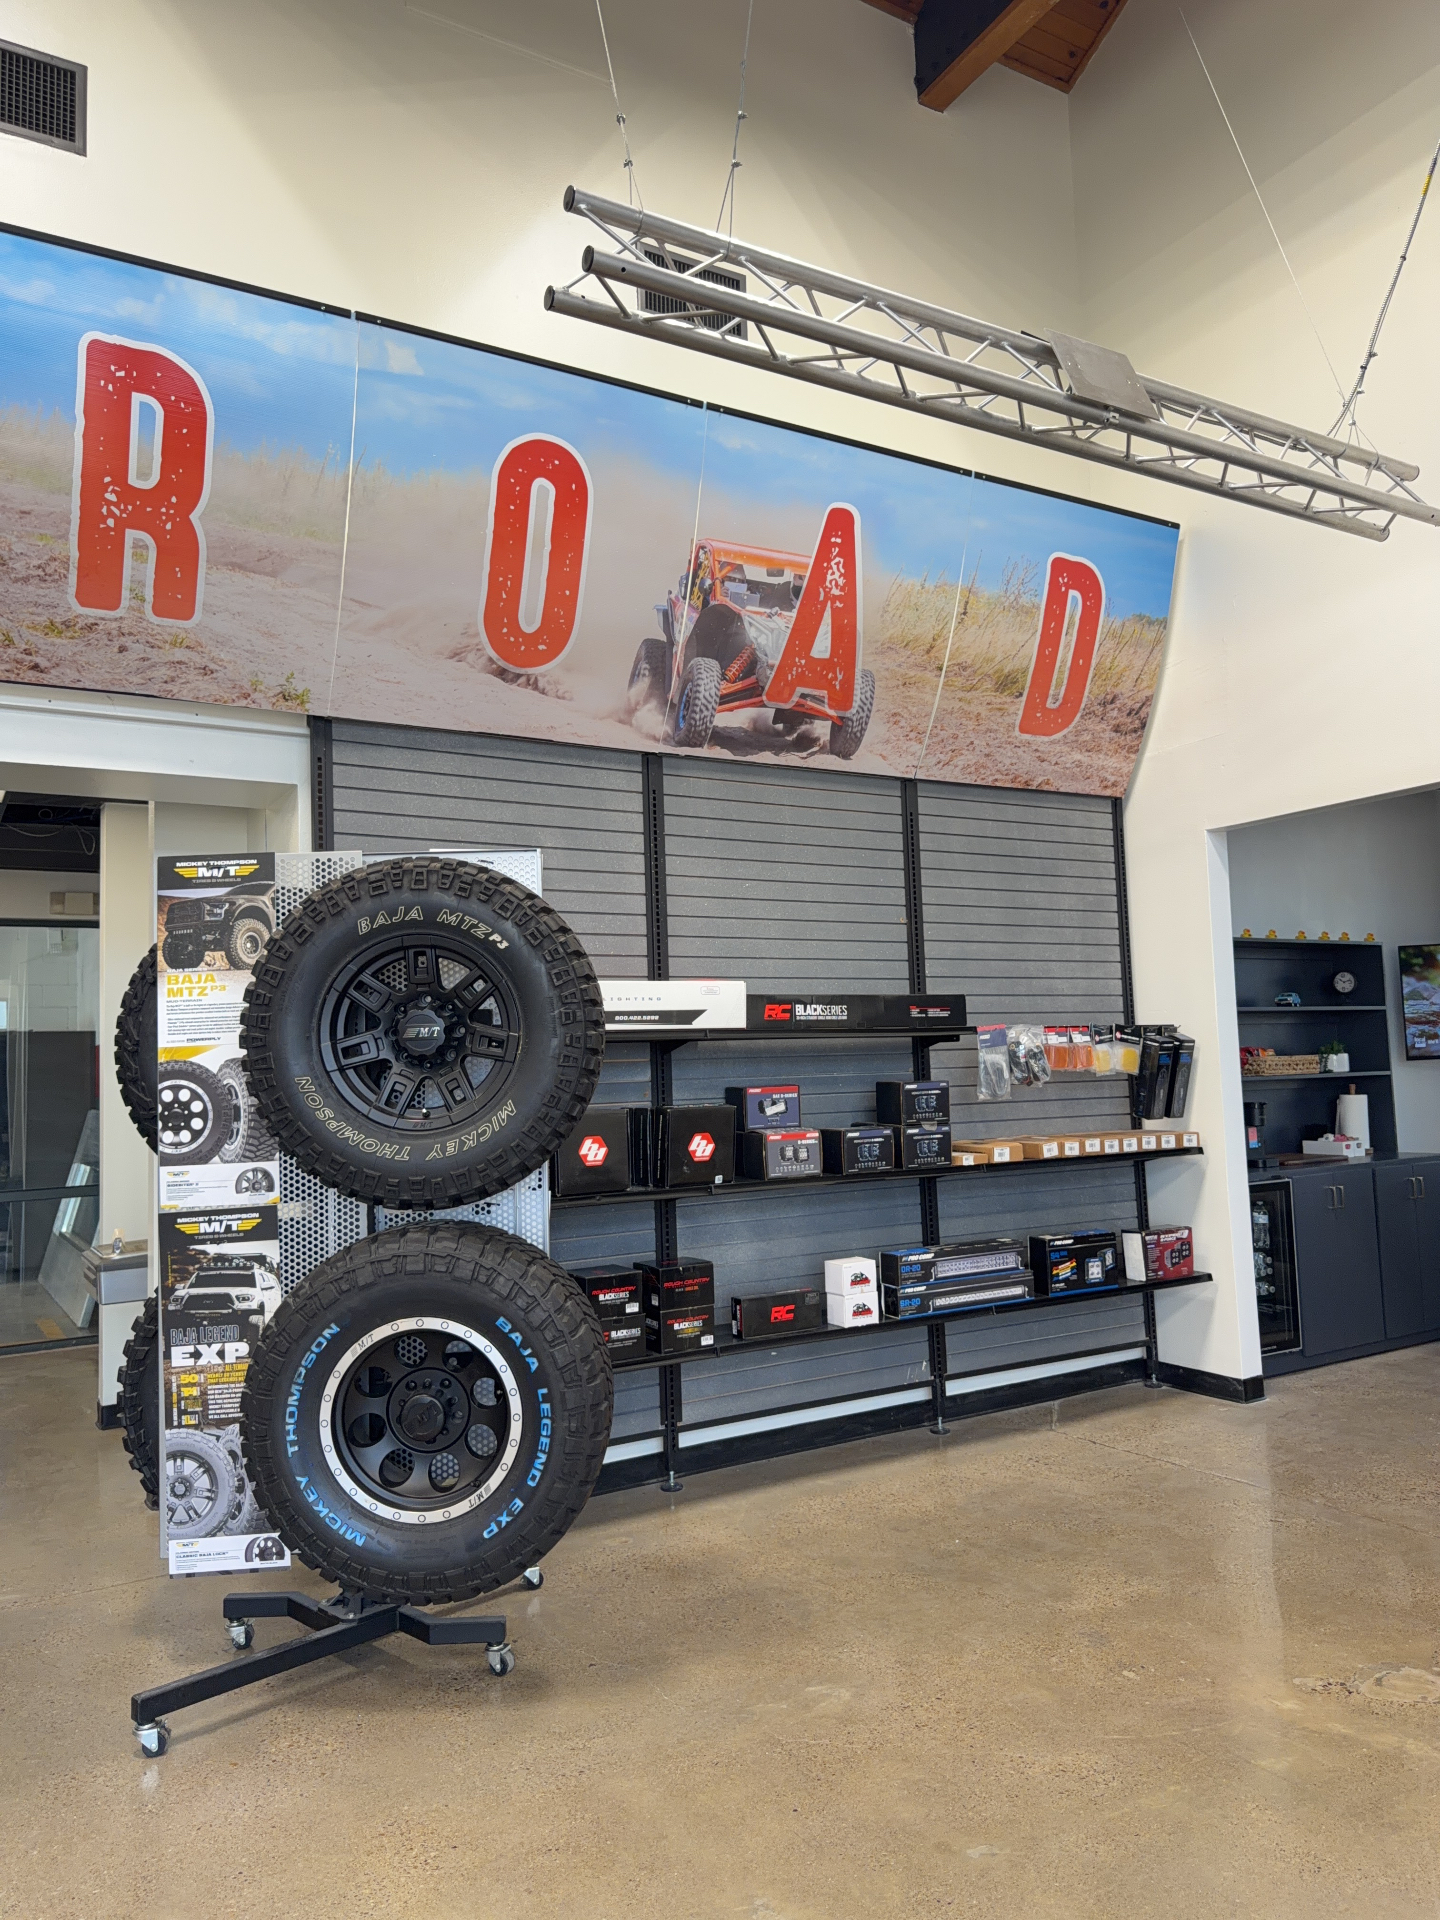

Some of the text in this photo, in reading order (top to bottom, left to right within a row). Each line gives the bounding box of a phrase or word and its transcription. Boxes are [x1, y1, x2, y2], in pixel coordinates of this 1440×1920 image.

[198, 866, 240, 877] M/T
[358, 906, 510, 949] BAJA MTZ P3
[167, 973, 217, 985] BAJA
[167, 986, 209, 998] MTZ
[764, 1004, 792, 1020] RC
[418, 1026, 441, 1038] M/T
[295, 1076, 517, 1161] MICKEY THOMPSON
[176, 1213, 259, 1223] MICKEY THOMPSON
[199, 1220, 242, 1233] M/T
[770, 1304, 796, 1323] RC
[170, 1324, 240, 1345] BAJA LEGEND
[356, 1333, 375, 1351] M/T
[170, 1341, 250, 1368] EXP
[285, 1322, 367, 1547] MICKEY THOMPSON
[482, 1316, 553, 1539] BAJA LEGEND EXP
[468, 1491, 485, 1508] M/T
